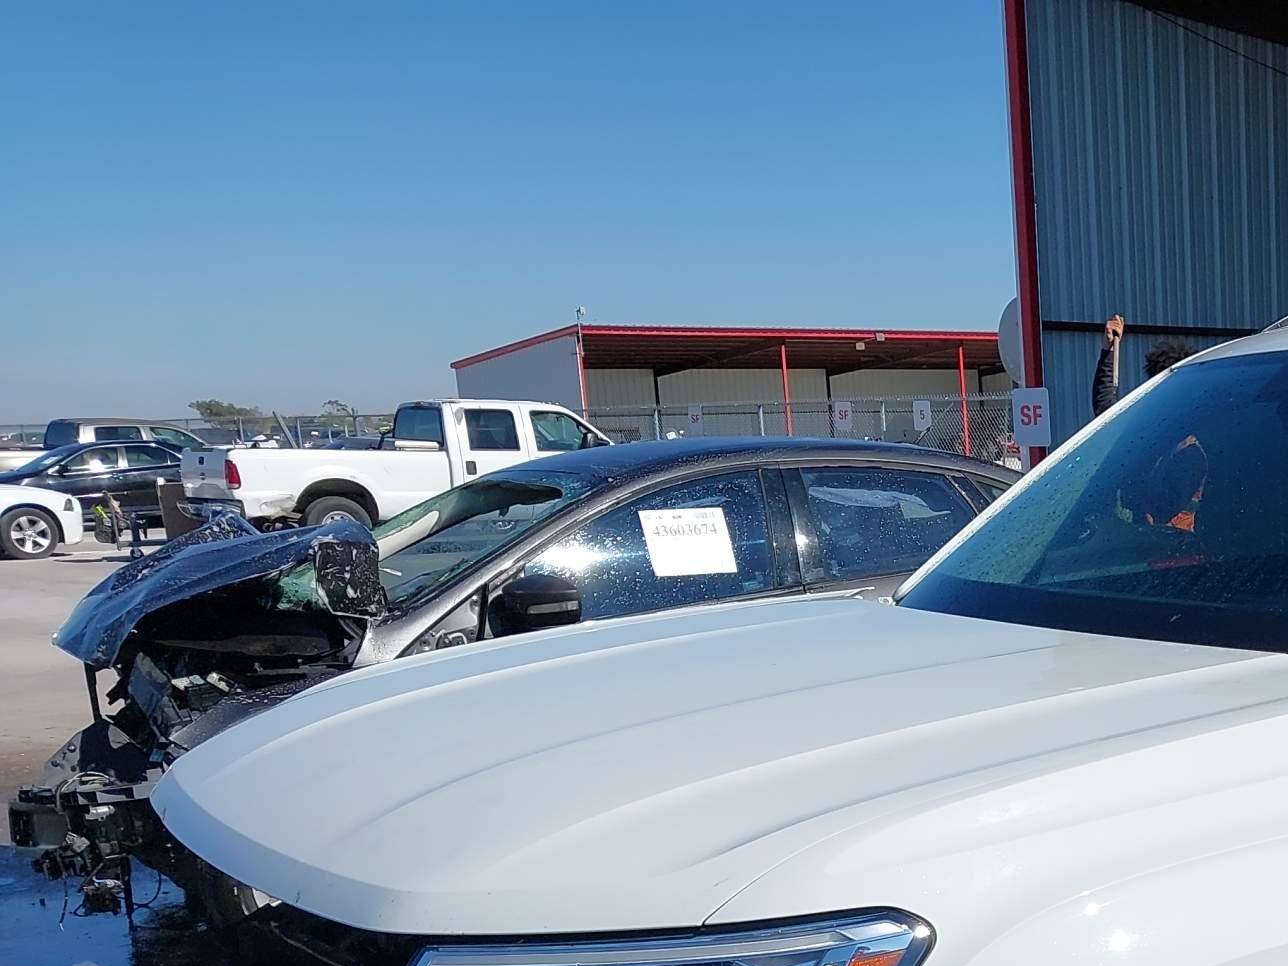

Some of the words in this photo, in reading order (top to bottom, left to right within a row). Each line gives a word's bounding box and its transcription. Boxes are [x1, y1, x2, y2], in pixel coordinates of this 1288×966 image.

[690, 414, 700, 424] SF
[838, 409, 849, 420] SF
[919, 409, 926, 420] 5
[1019, 404, 1043, 426] SF
[653, 523, 718, 537] 43603674
